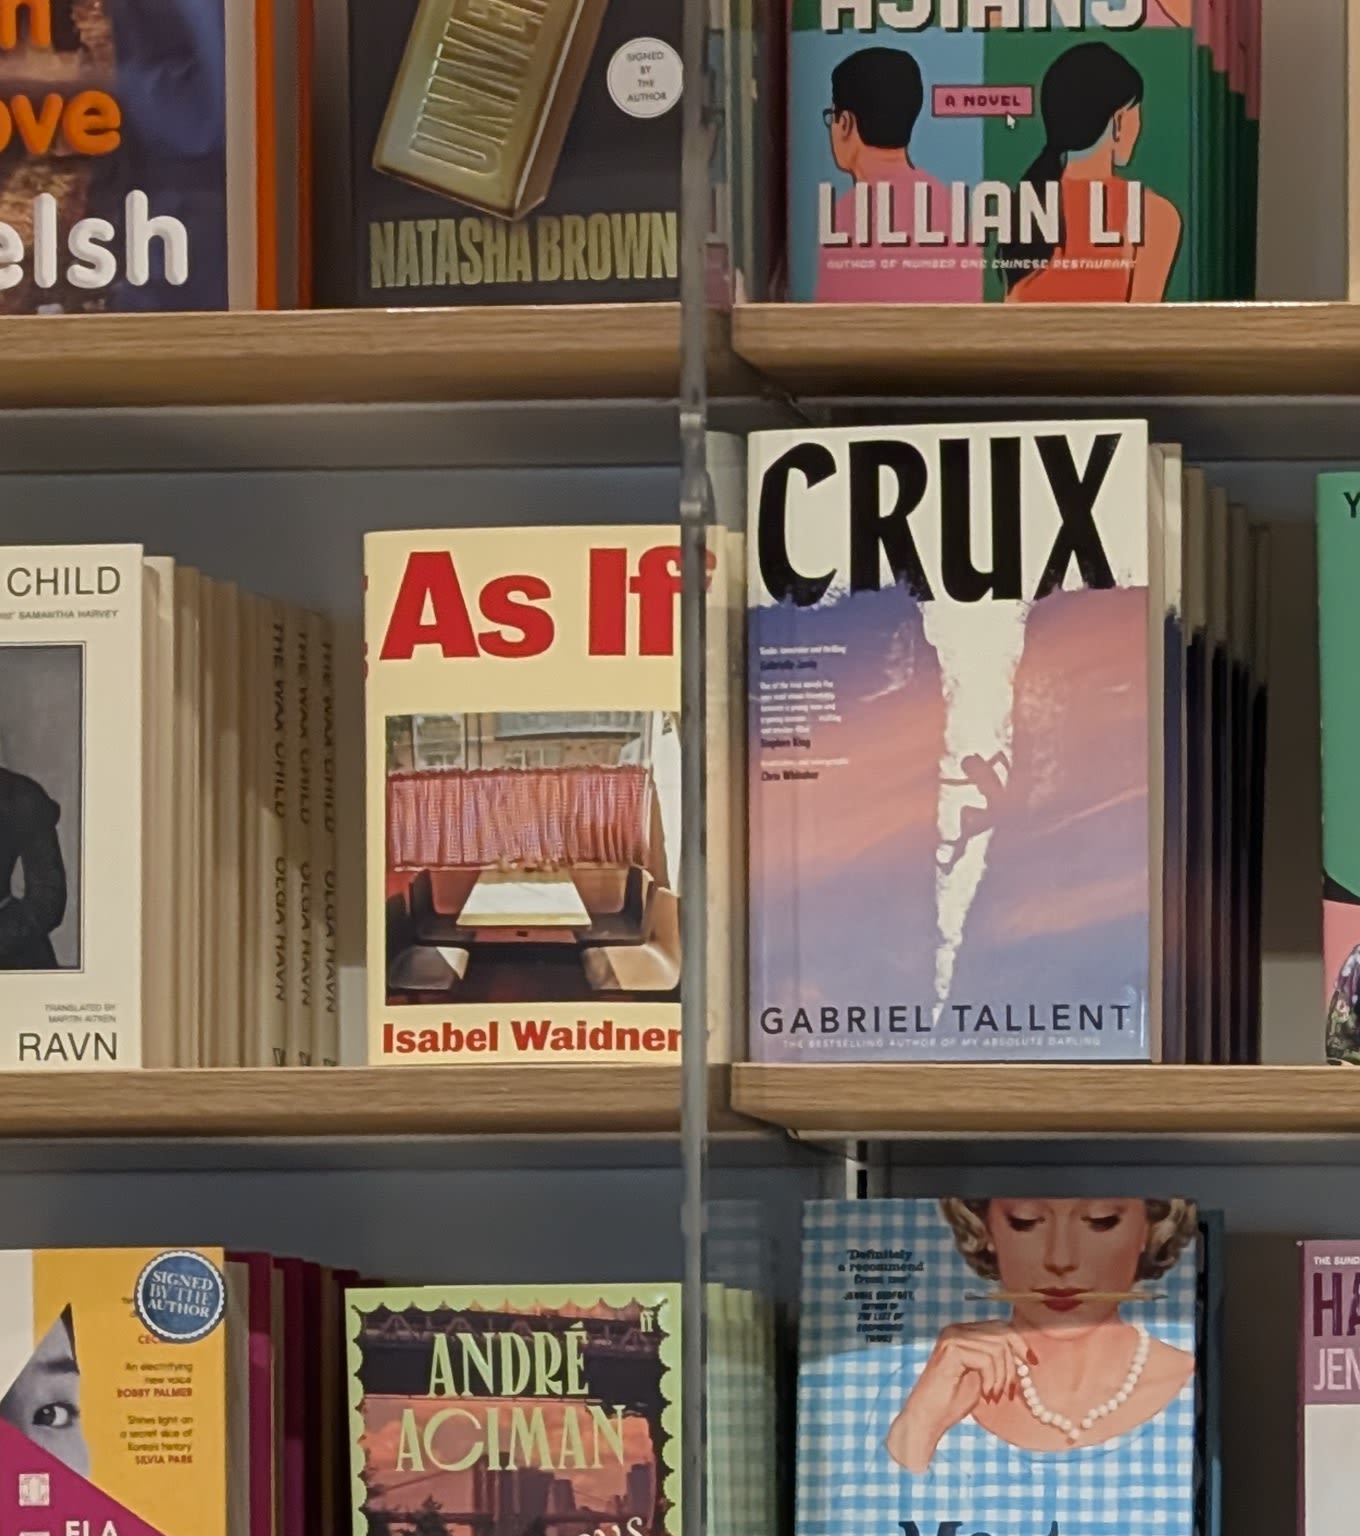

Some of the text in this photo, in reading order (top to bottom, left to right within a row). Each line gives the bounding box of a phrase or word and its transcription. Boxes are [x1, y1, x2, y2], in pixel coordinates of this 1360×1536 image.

[944, 94, 1021, 109] A NOVEL
[819, 180, 1144, 247] LILLIAN LI
[370, 212, 677, 288] NATASHA BROWN
[757, 432, 1122, 604] CRUX
[6, 565, 122, 596] CHILD
[18, 1032, 118, 1062] RAVN
[760, 1004, 1130, 1035] GABRIEL TALLENT
[428, 1324, 589, 1398] ANDRÉ
[394, 1404, 626, 1473] ACIMAN
